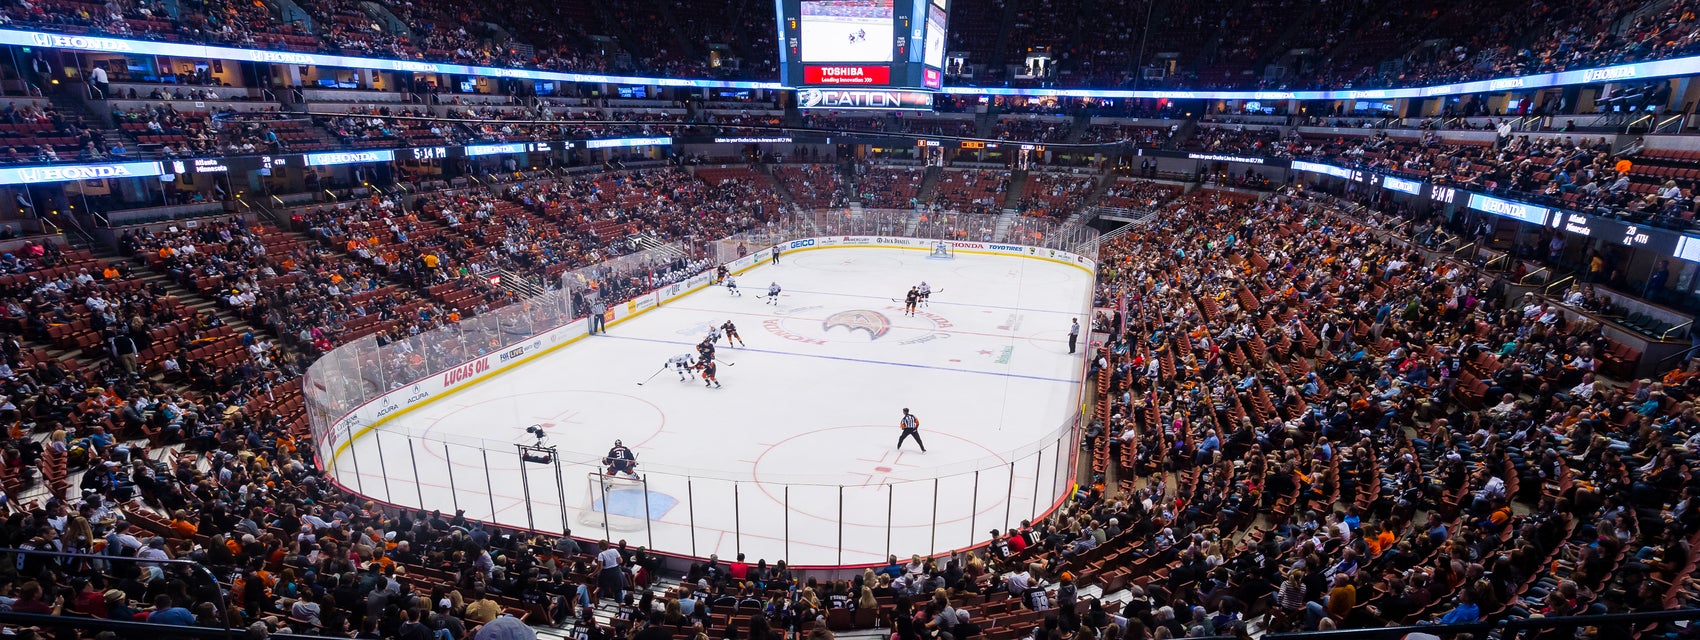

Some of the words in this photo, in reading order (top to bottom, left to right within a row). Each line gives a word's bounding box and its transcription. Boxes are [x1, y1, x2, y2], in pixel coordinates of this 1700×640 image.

[791, 21, 797, 29] 3
[52, 37, 132, 52] HONDA
[263, 50, 316, 64] HONDA
[402, 63, 439, 72] HONDA
[504, 69, 529, 77] HONDA
[821, 68, 863, 76] TOSHIBA
[1593, 66, 1635, 81] HONDA
[1433, 86, 1451, 94] HONDA
[1495, 79, 1523, 89] HONDA
[414, 148, 433, 159] 5:14
[436, 147, 446, 158] PM
[485, 145, 515, 153] HONDA
[329, 153, 378, 163] HONDA
[43, 166, 132, 181] HONDA
[195, 165, 227, 173] Minnesota
[1393, 181, 1413, 191] HONDA
[1431, 186, 1446, 202] 5:14
[1445, 188, 1455, 203] PM
[1489, 202, 1526, 219] HONDA
[1565, 223, 1591, 236] Minnesota
[1623, 236, 1633, 246] 41
[1568, 214, 1587, 225] Atlanta
[1625, 225, 1637, 236] 28
[1634, 233, 1649, 244] 4TH
[791, 239, 814, 249] GEICO
[500, 352, 509, 360] FOX
[511, 348, 522, 357] LIVE
[444, 362, 473, 387] LUCAS
[475, 358, 489, 374] OIL
[407, 391, 428, 404] ACURA
[377, 404, 398, 418] ACURA
[616, 451, 625, 459] 31
[1002, 546, 1010, 557] 8
[16, 552, 25, 570] 8
